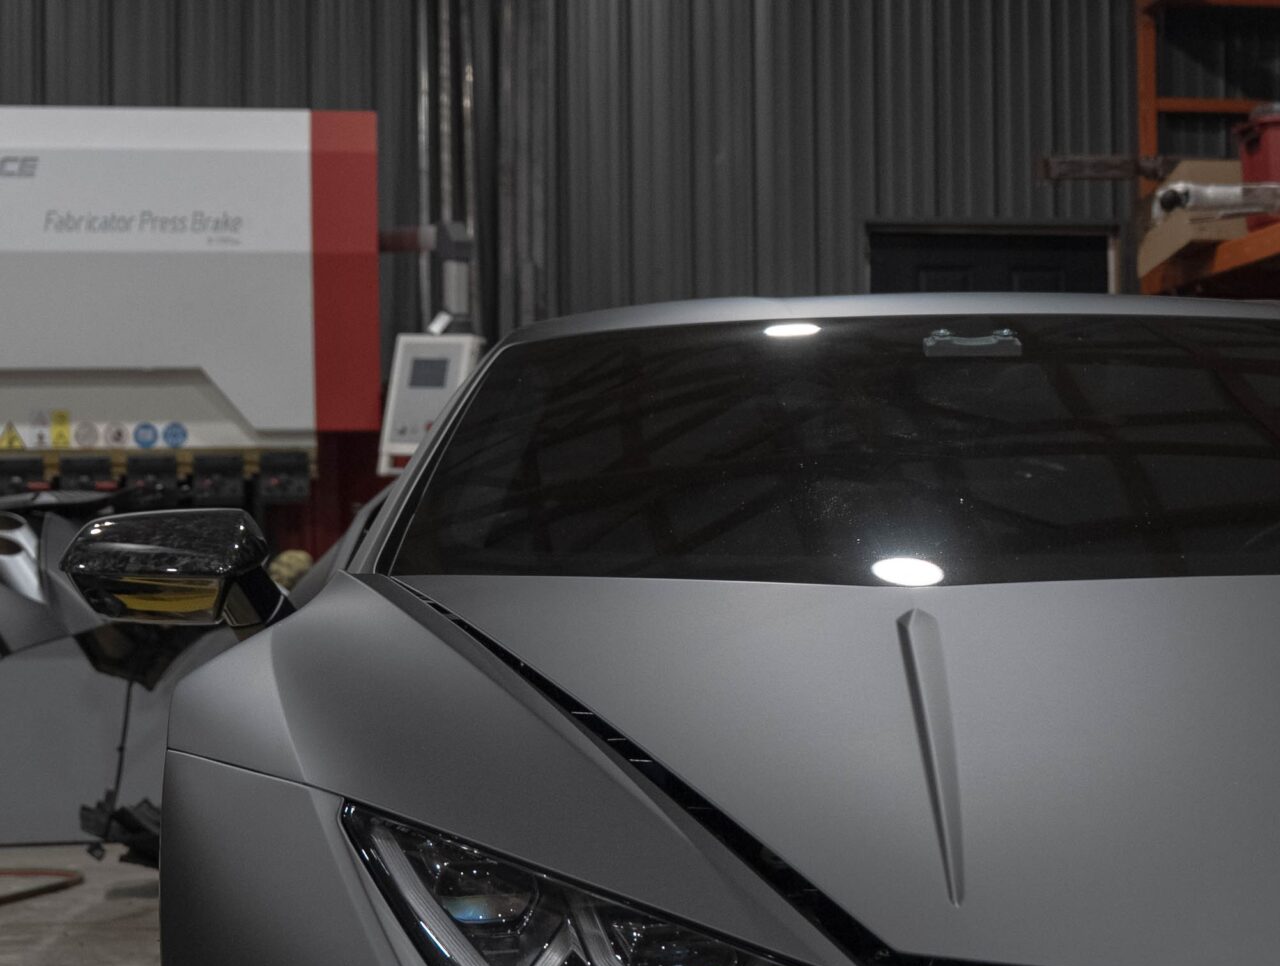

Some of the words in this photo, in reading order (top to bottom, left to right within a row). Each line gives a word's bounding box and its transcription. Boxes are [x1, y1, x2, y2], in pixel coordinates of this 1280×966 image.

[43, 209, 136, 233] Fabricator
[137, 209, 188, 233] Press
[190, 209, 243, 233] Brake
